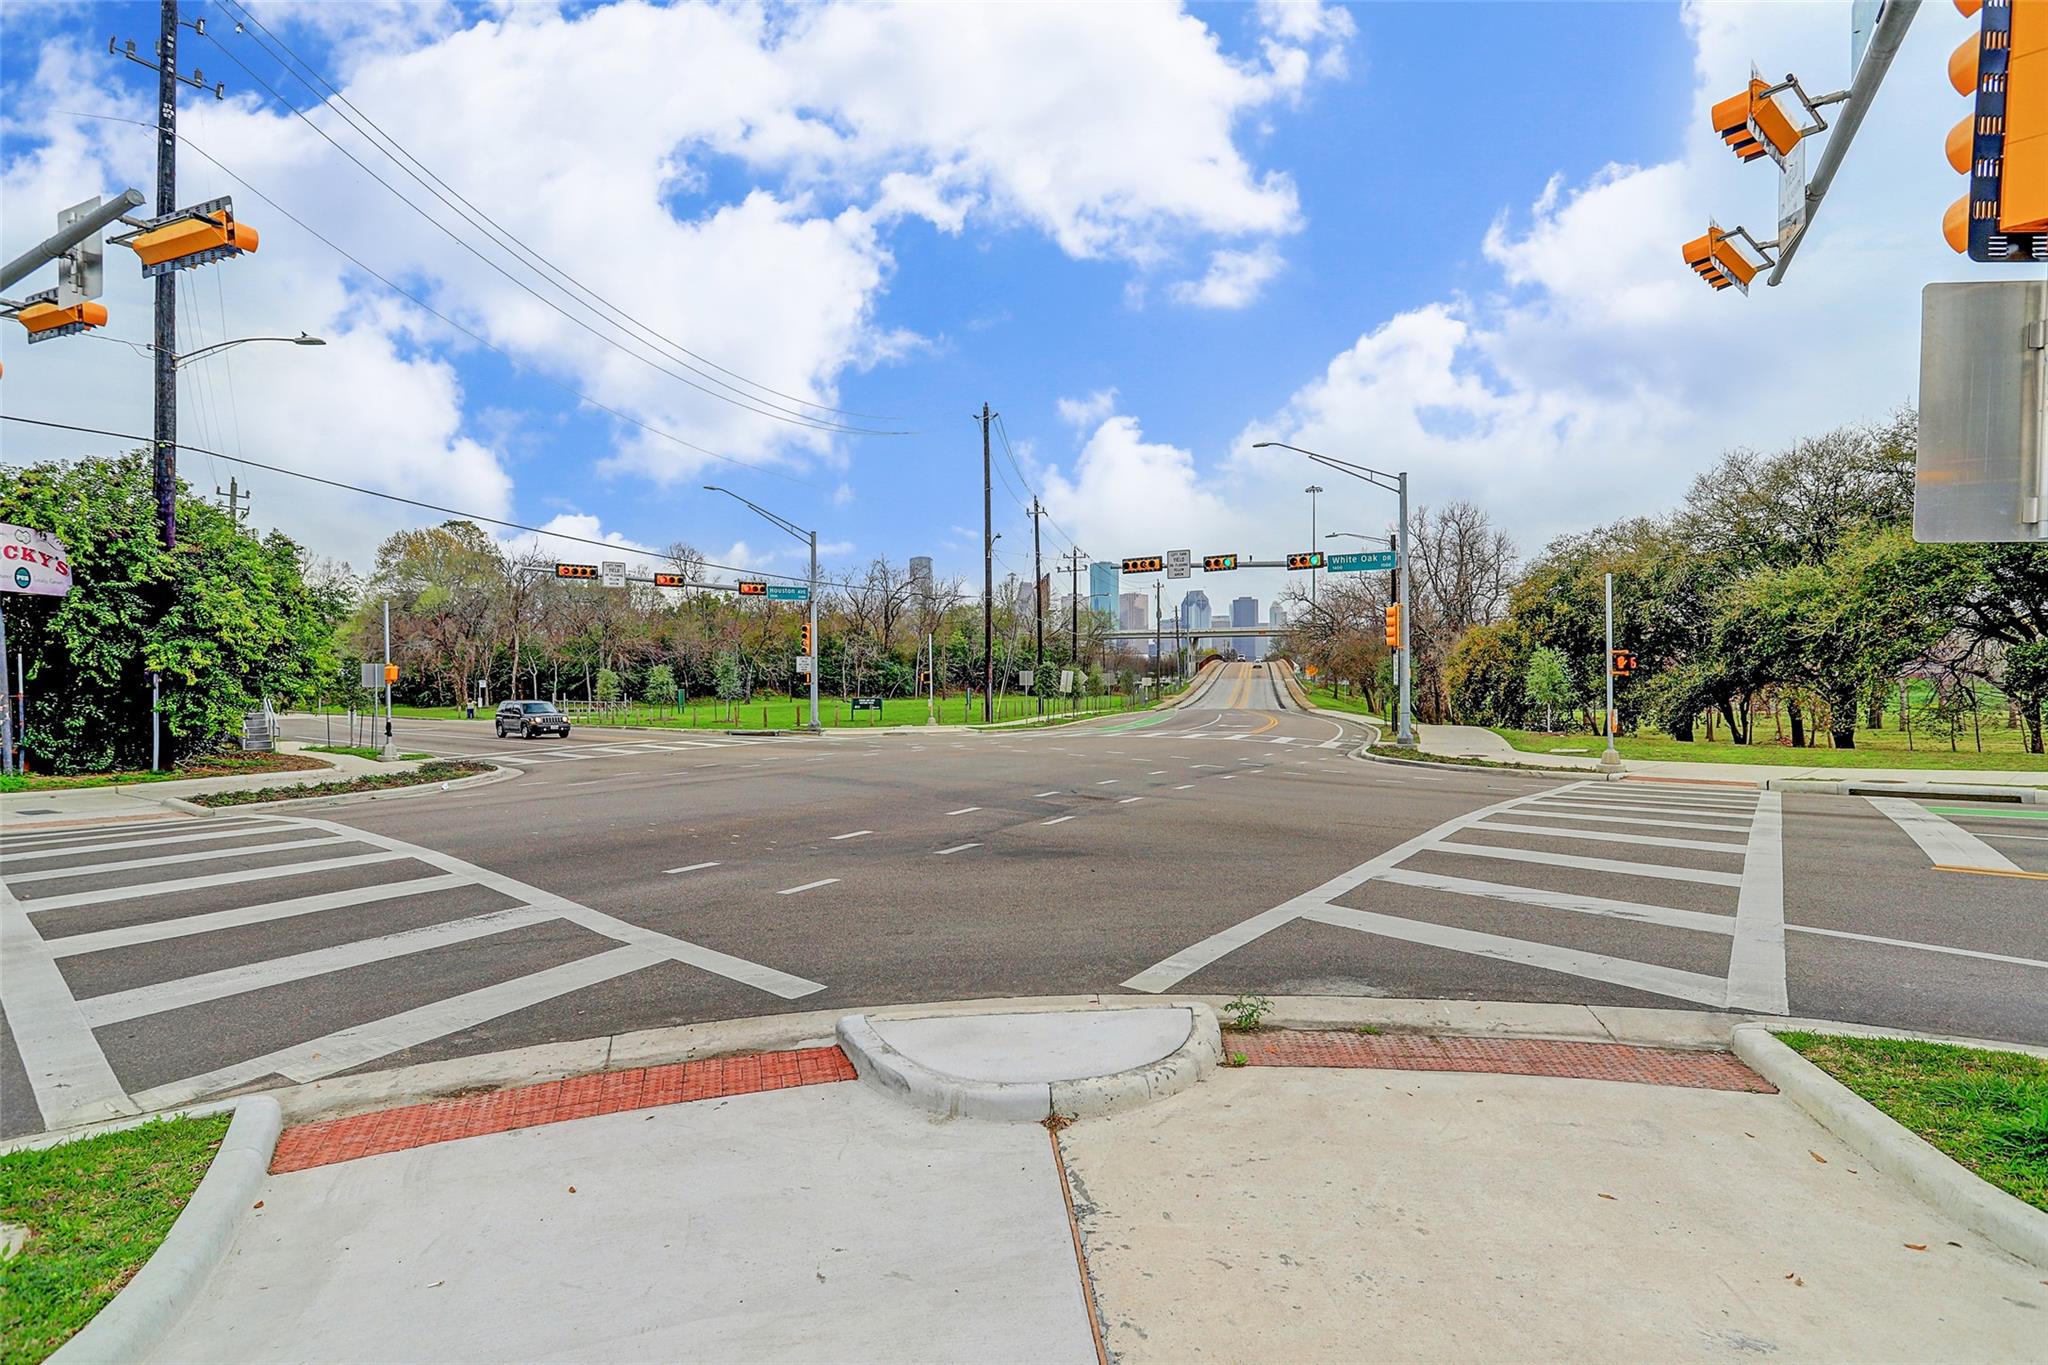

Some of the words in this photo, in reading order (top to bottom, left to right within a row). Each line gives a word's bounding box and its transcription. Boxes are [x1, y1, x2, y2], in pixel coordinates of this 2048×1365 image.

[2, 544, 70, 577] CKY'S
[1331, 555, 1358, 565] White
[1360, 554, 1378, 563] Oak
